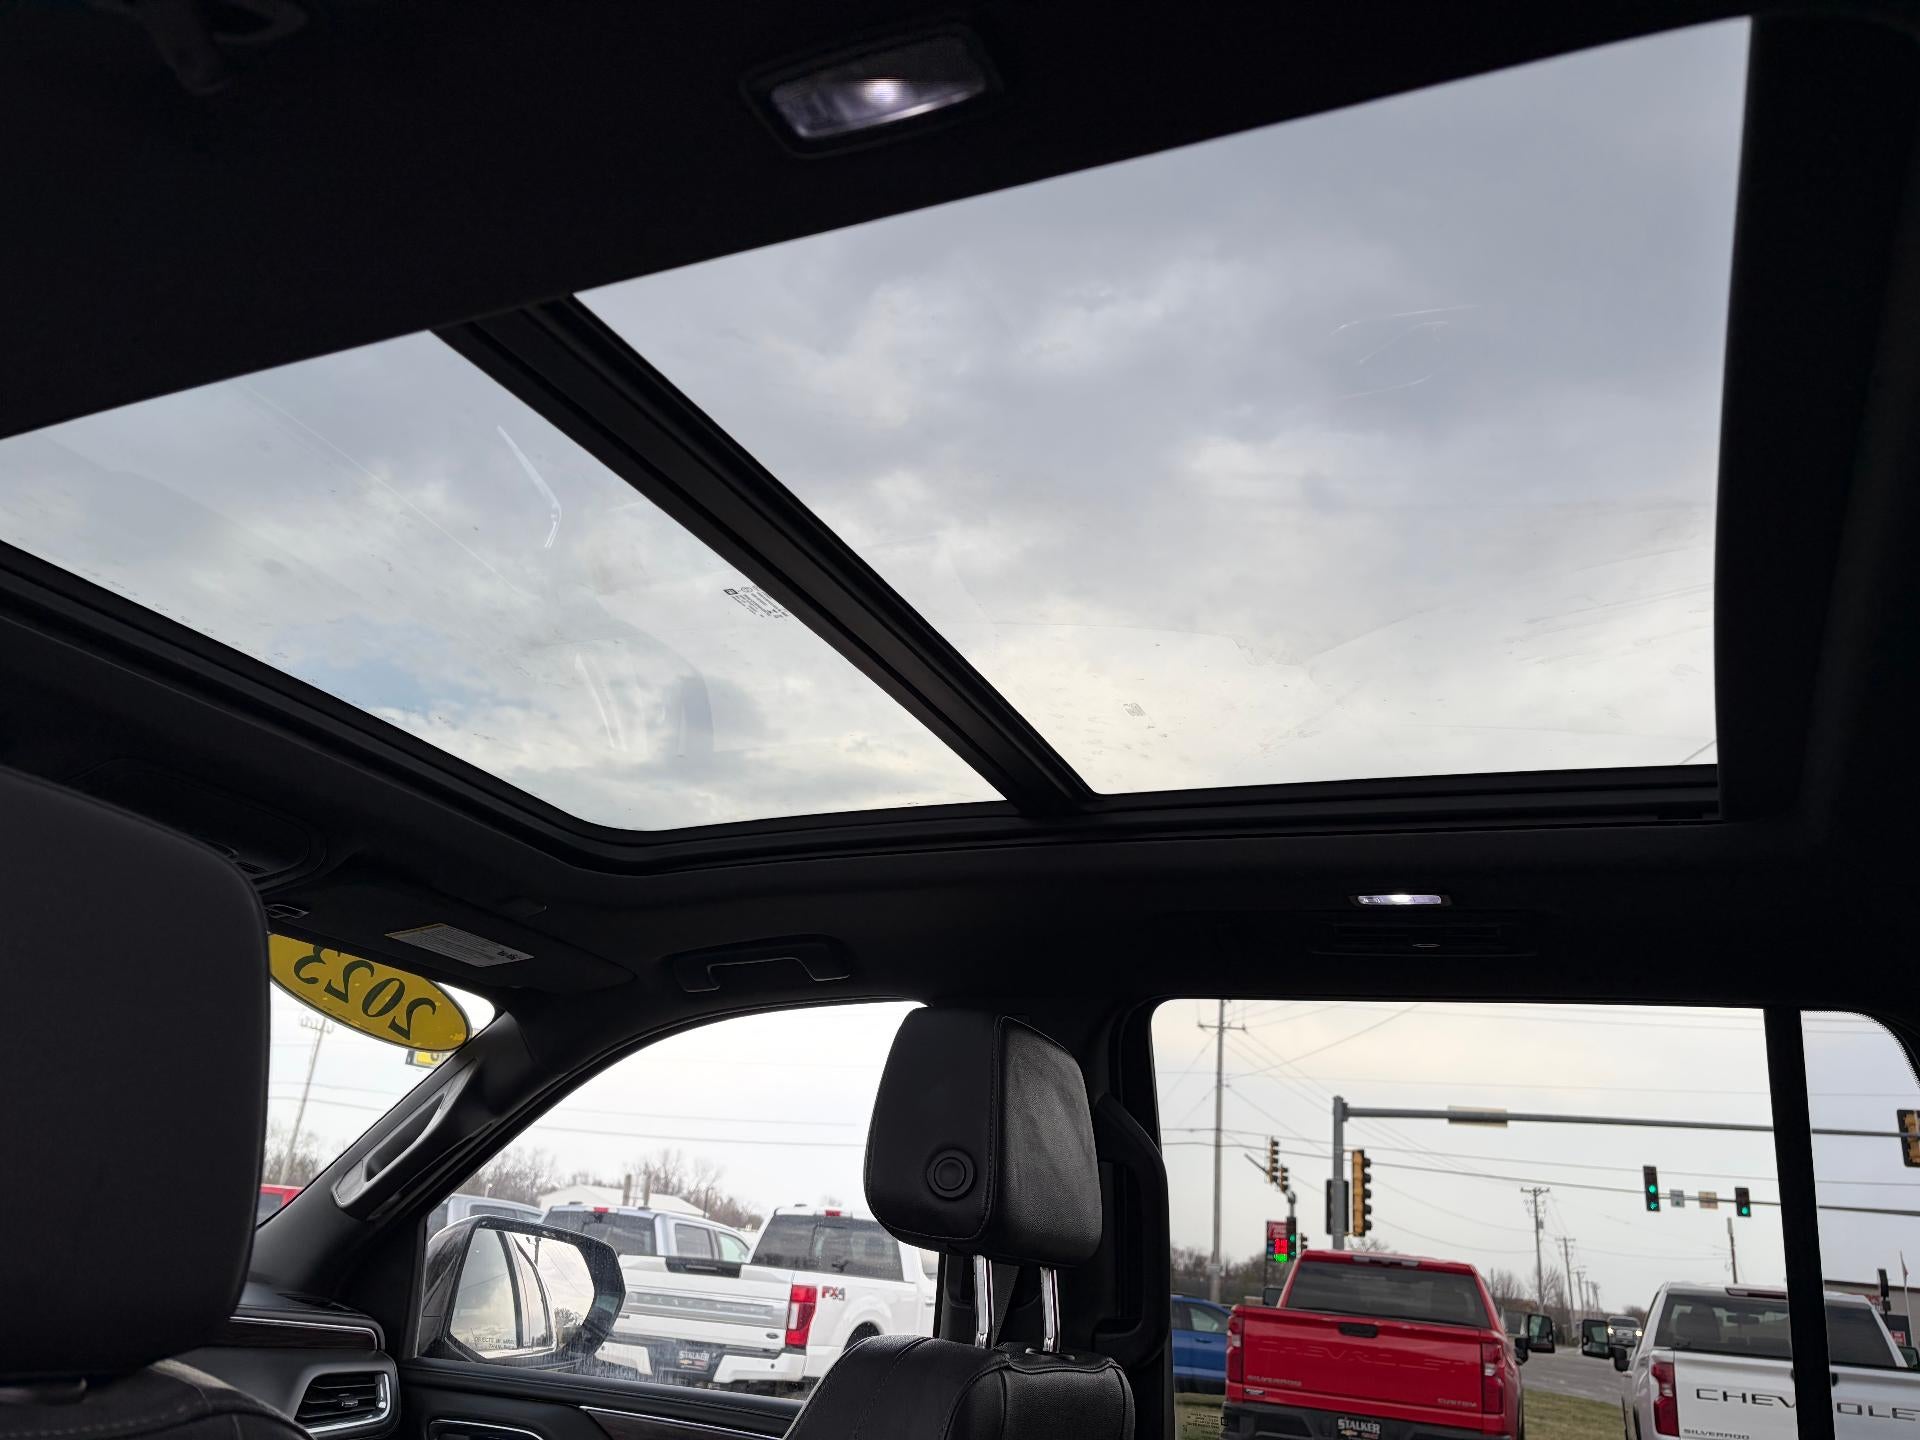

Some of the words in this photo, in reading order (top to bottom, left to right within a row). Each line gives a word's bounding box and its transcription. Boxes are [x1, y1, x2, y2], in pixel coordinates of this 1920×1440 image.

[821, 1285, 846, 1301] FX4
[679, 1350, 709, 1361] STALKER
[1337, 1418, 1381, 1434] STALKER
[1683, 1427, 1750, 1440] SILVERADO
